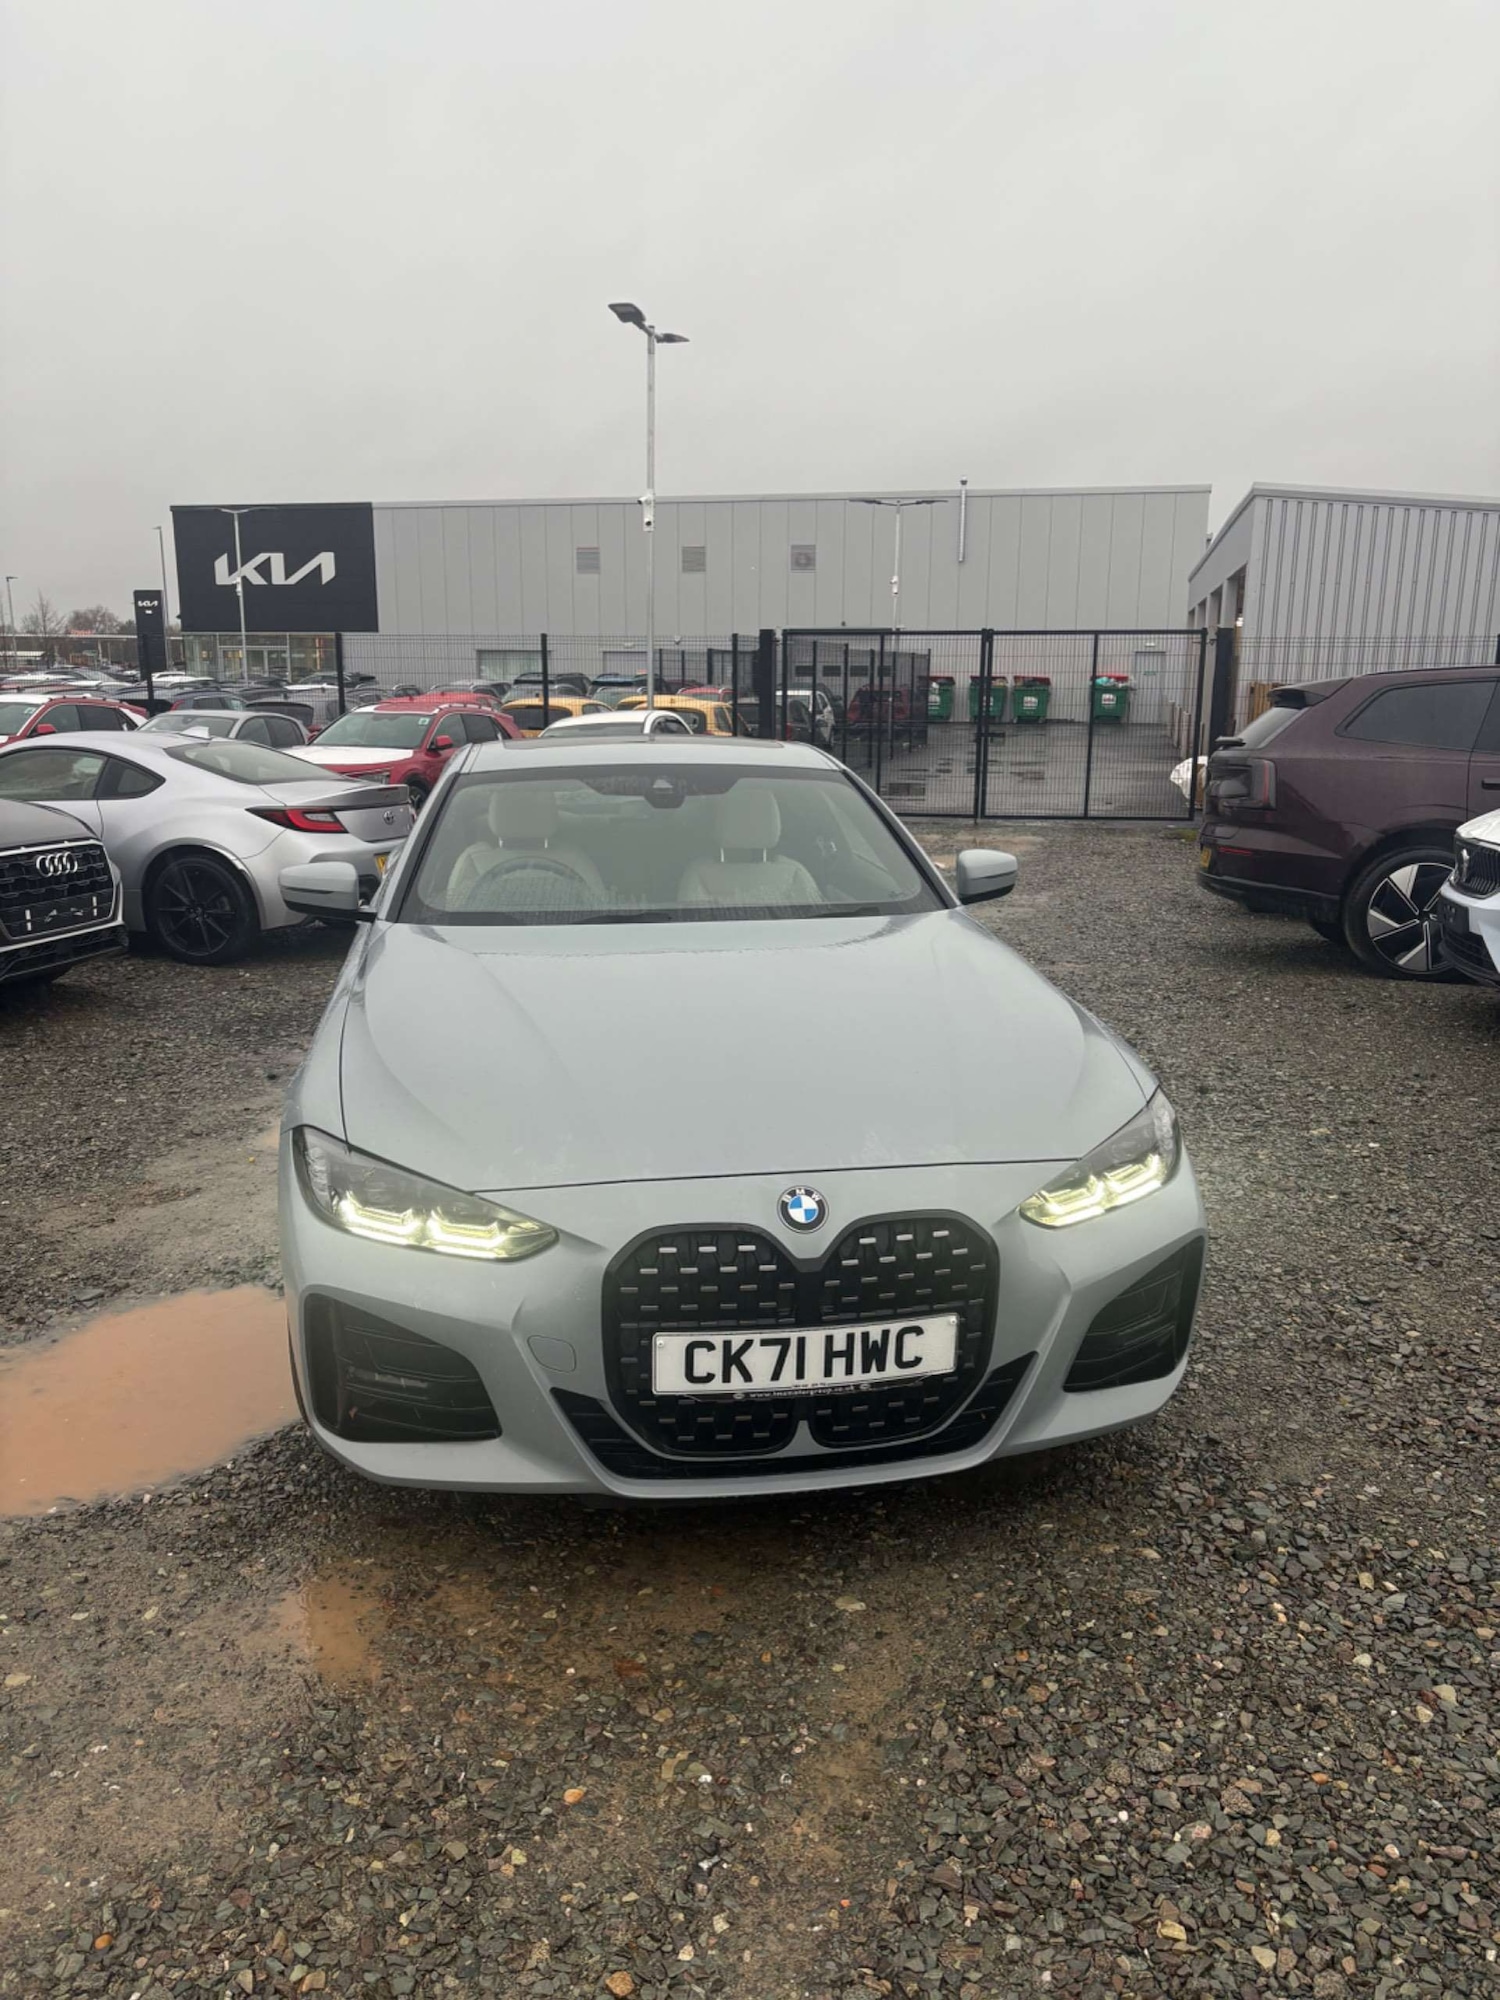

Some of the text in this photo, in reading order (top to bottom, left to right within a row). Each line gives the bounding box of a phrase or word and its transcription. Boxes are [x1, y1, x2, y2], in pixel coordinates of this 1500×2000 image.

[214, 551, 336, 585] KIA
[781, 1188, 821, 1203] BMW
[684, 1325, 925, 1384] CK71 HWC
